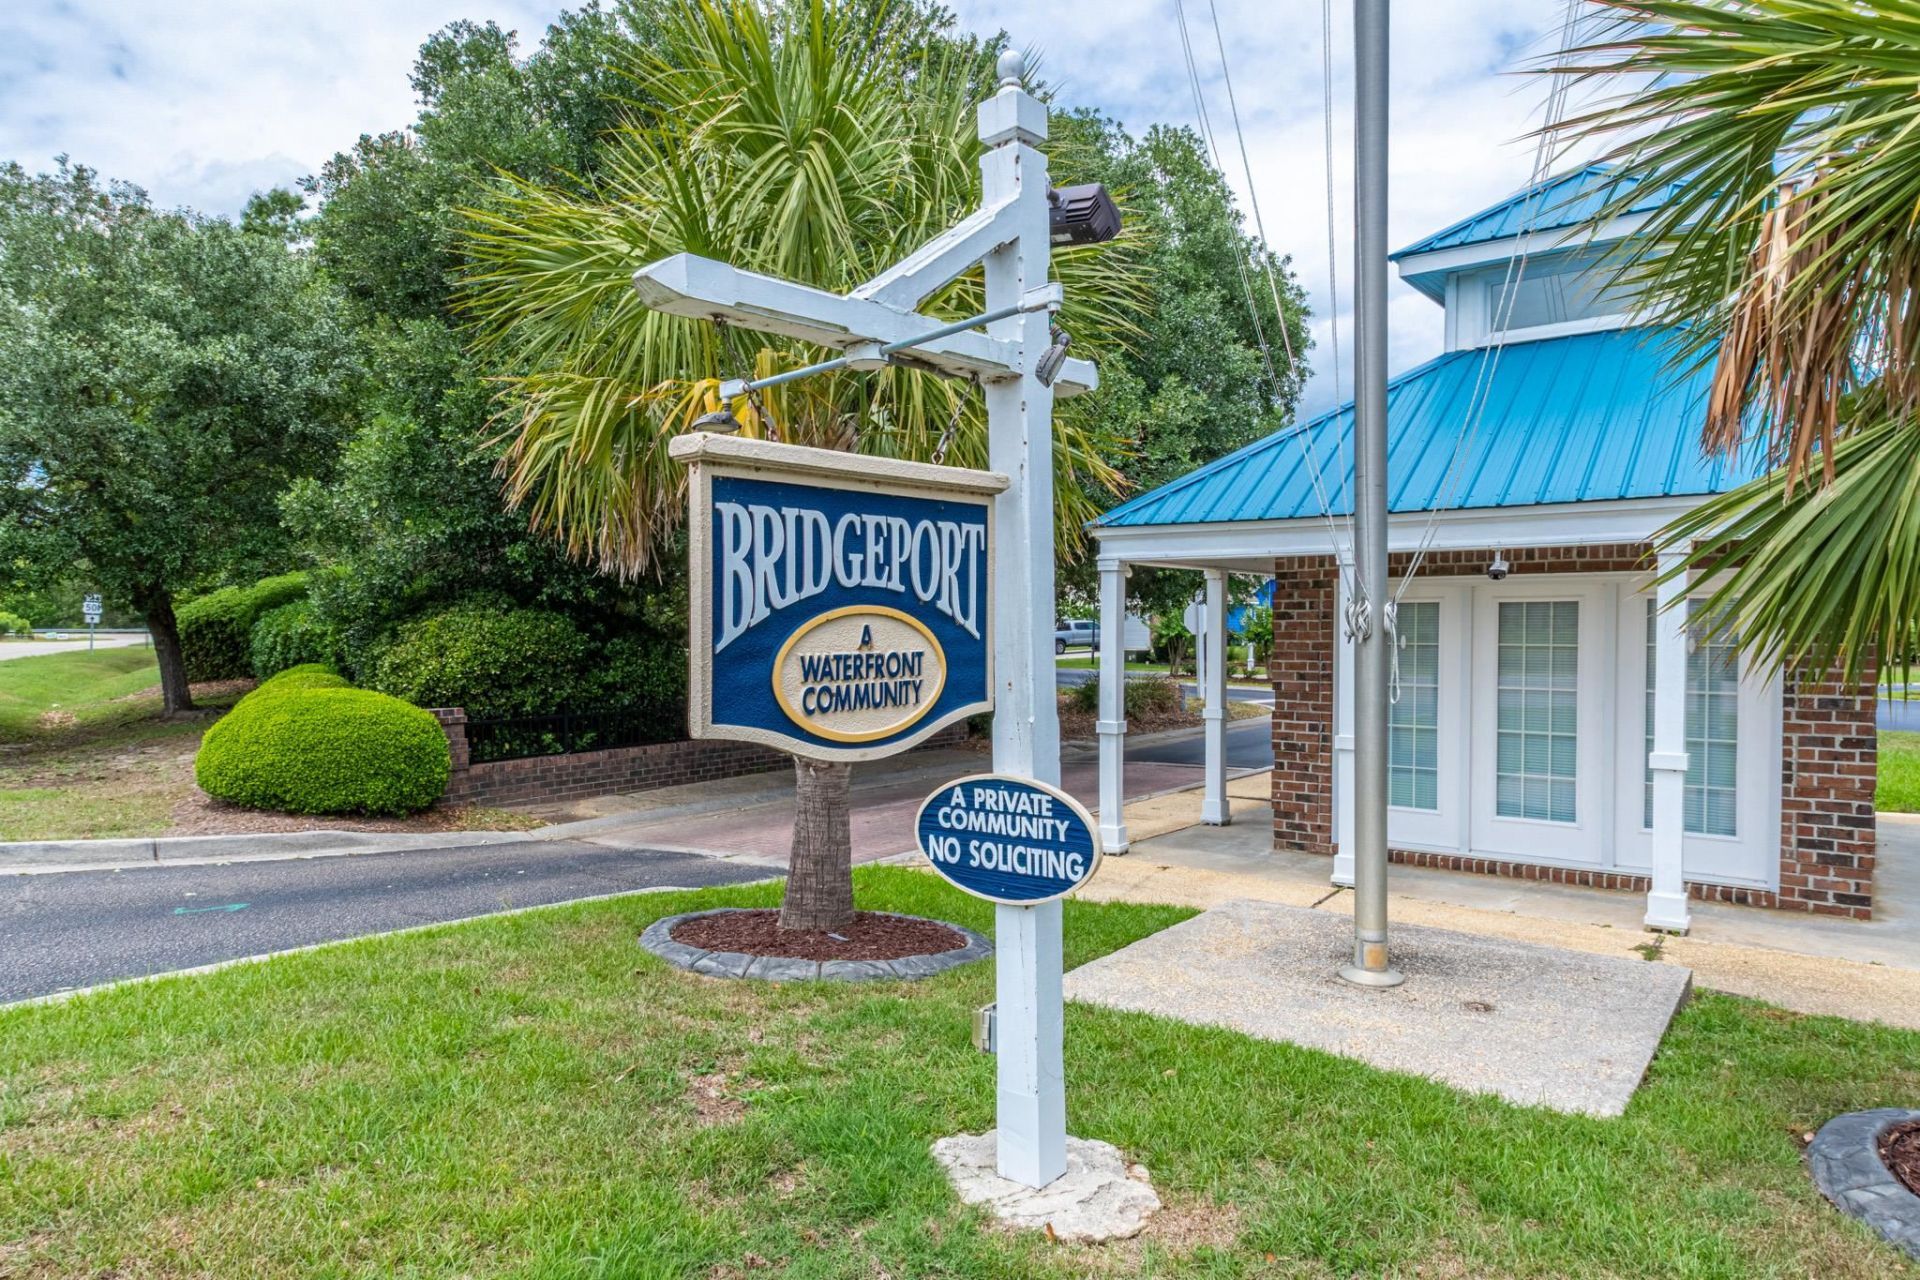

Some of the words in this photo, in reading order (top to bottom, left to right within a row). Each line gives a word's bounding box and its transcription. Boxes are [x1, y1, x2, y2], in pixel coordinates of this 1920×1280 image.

[715, 502, 985, 654] BRIDGEPORT
[860, 624, 873, 646] A
[800, 651, 925, 682] WATERFRONT
[802, 679, 923, 716] COMMUNITY
[950, 786, 966, 808] A
[973, 787, 1053, 816] PRIVATE
[938, 807, 1070, 842] COMMUNITY
[928, 834, 961, 864] NO
[969, 839, 1084, 882] SOLICITING
